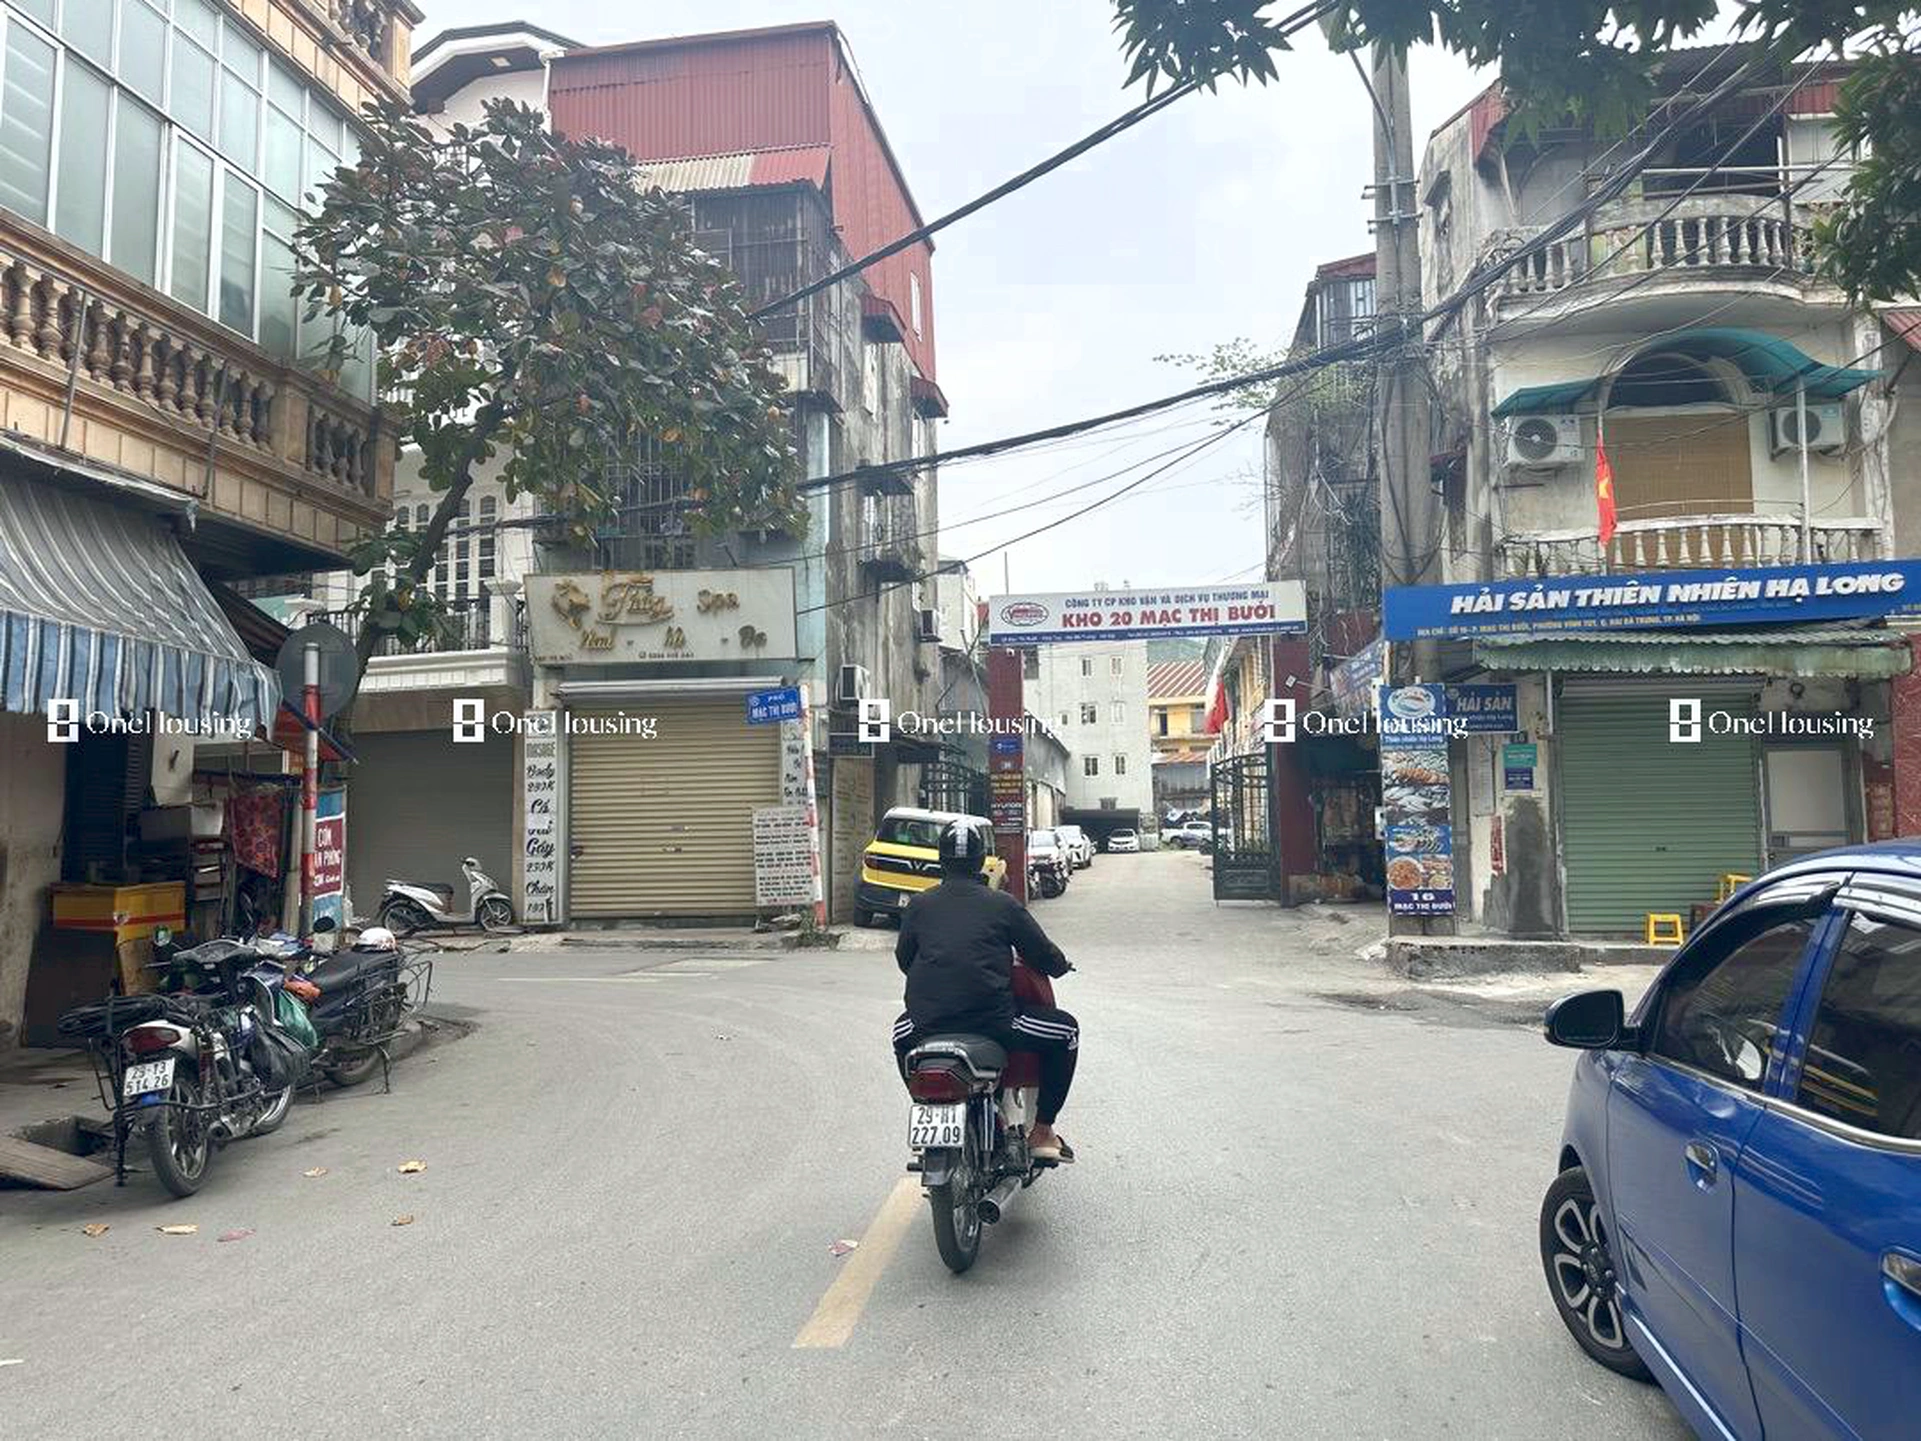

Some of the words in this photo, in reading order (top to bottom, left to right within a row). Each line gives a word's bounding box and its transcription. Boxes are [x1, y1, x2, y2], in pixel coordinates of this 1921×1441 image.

[1065, 598, 1089, 609] CÔNG
[1092, 598, 1102, 608] TY
[1175, 593, 1195, 604] DỊCH
[1451, 587, 1504, 614] HẢI
[1509, 584, 1571, 611] SẢN
[1575, 580, 1662, 608] THIÊN
[1666, 576, 1761, 603] NHIÊN
[1765, 577, 1810, 603] HẠ
[1815, 572, 1905, 596] LONG
[1062, 611, 1102, 628] KHO
[1109, 611, 1132, 627] 20
[1140, 608, 1181, 627] MẠC
[1189, 607, 1219, 626] THỊ
[1456, 691, 1480, 712] HẢI
[911, 1125, 961, 1145] 227.09
